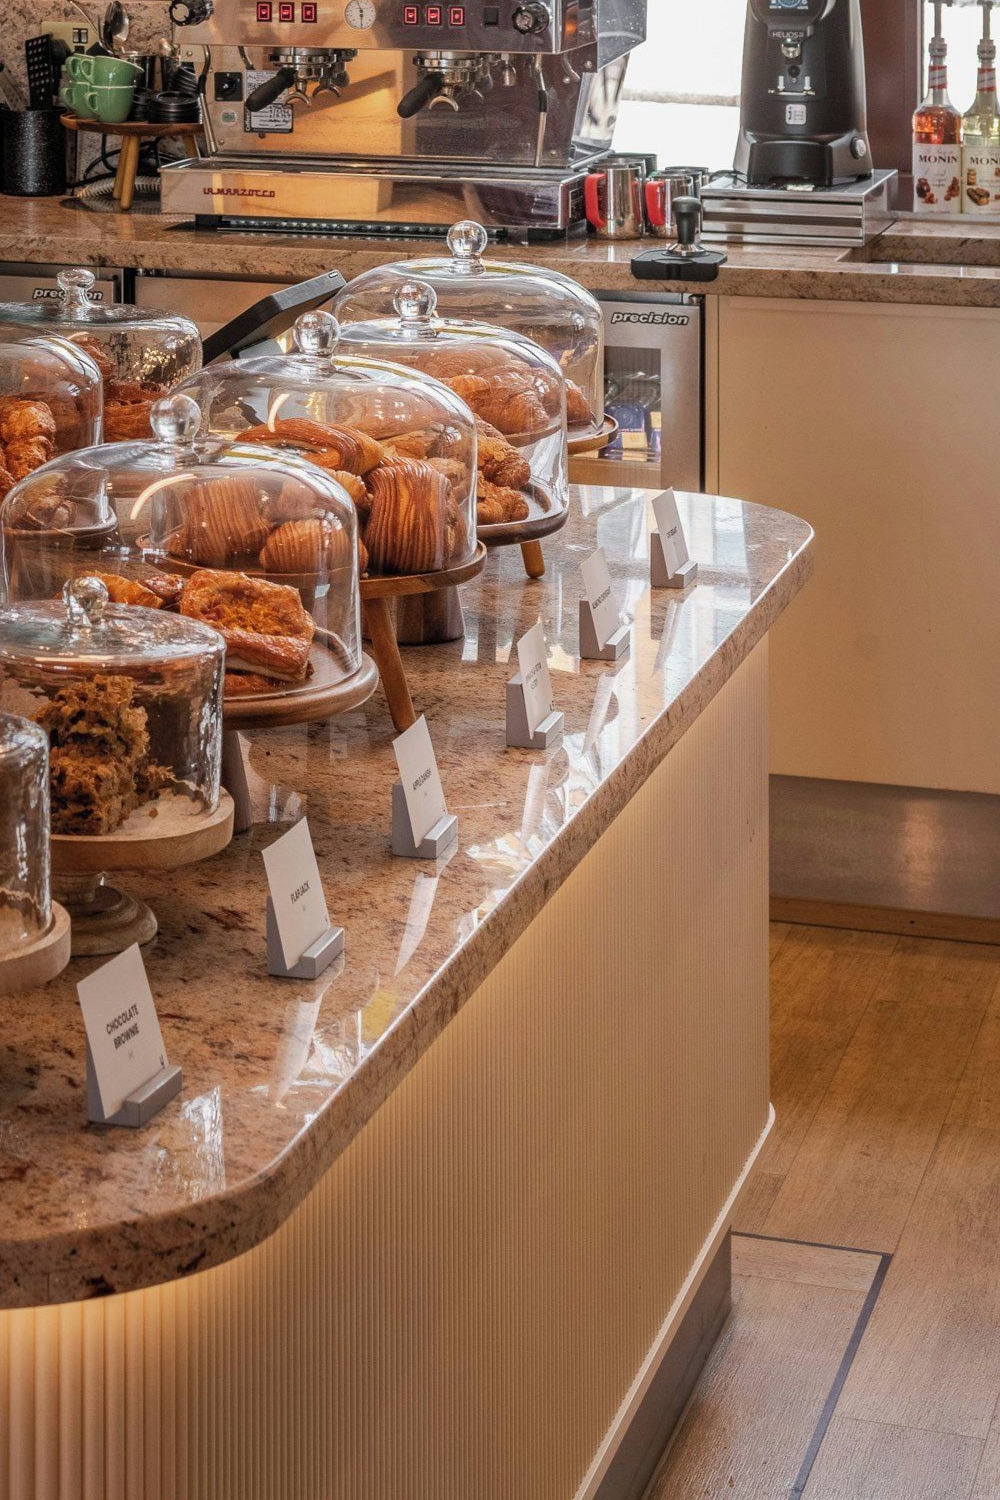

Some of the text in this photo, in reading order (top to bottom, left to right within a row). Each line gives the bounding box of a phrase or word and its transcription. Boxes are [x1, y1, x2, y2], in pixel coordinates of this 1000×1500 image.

[919, 154, 958, 163] MONIN
[970, 157, 1000, 165] MON
[32, 288, 103, 301] precon
[611, 312, 689, 325] precision
[106, 1004, 139, 1034] CHOCOLATE
[114, 1023, 139, 1049] BROWNIE
